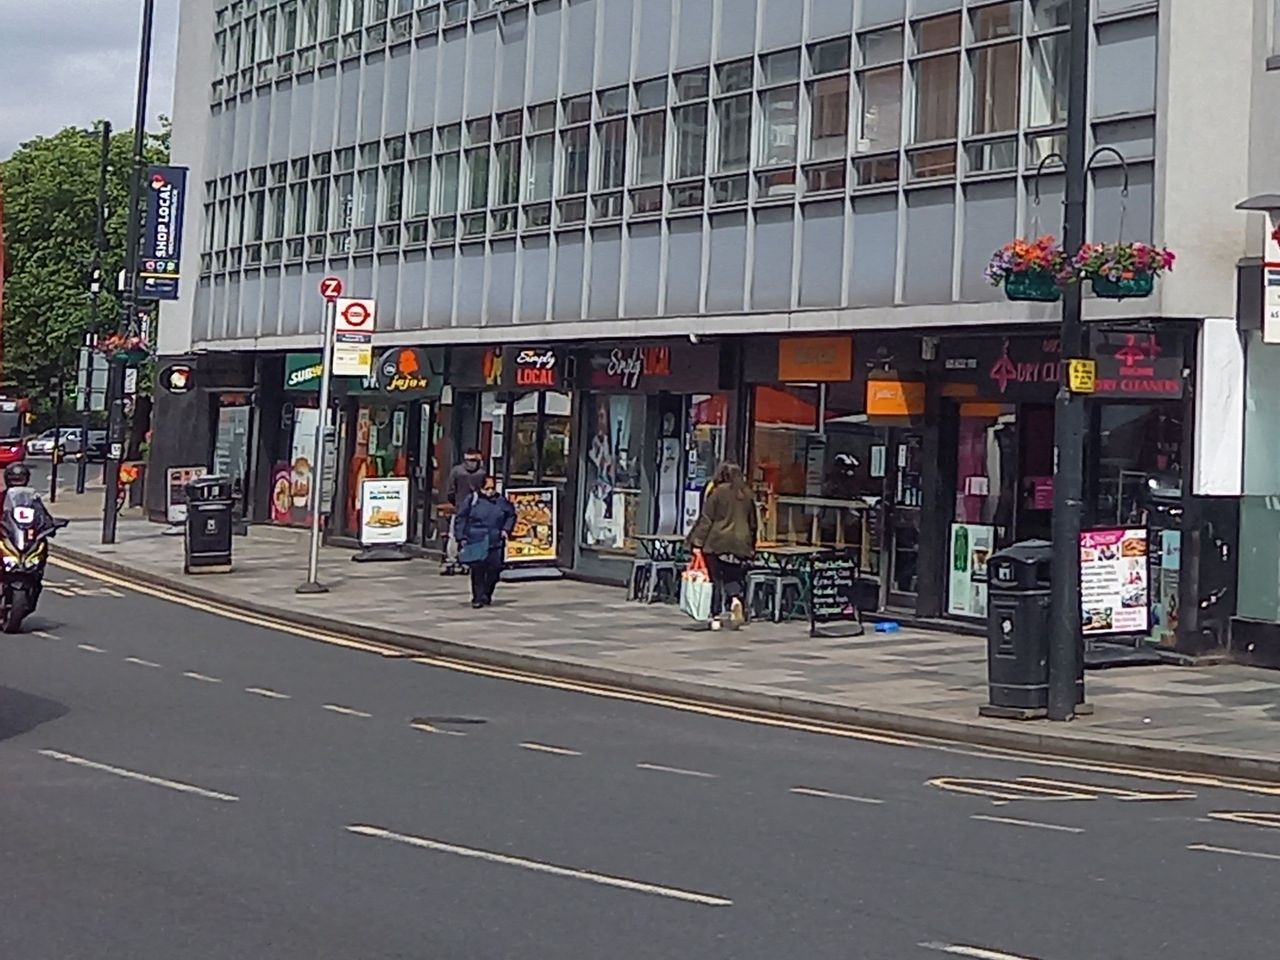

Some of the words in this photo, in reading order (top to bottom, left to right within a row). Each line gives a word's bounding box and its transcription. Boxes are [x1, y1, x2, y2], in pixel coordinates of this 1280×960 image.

[158, 184, 172, 223] LOCAL
[155, 224, 169, 258] SHOP
[324, 280, 339, 296] Z
[517, 368, 555, 385] LOCAL
[1017, 362, 1040, 383] DRY
